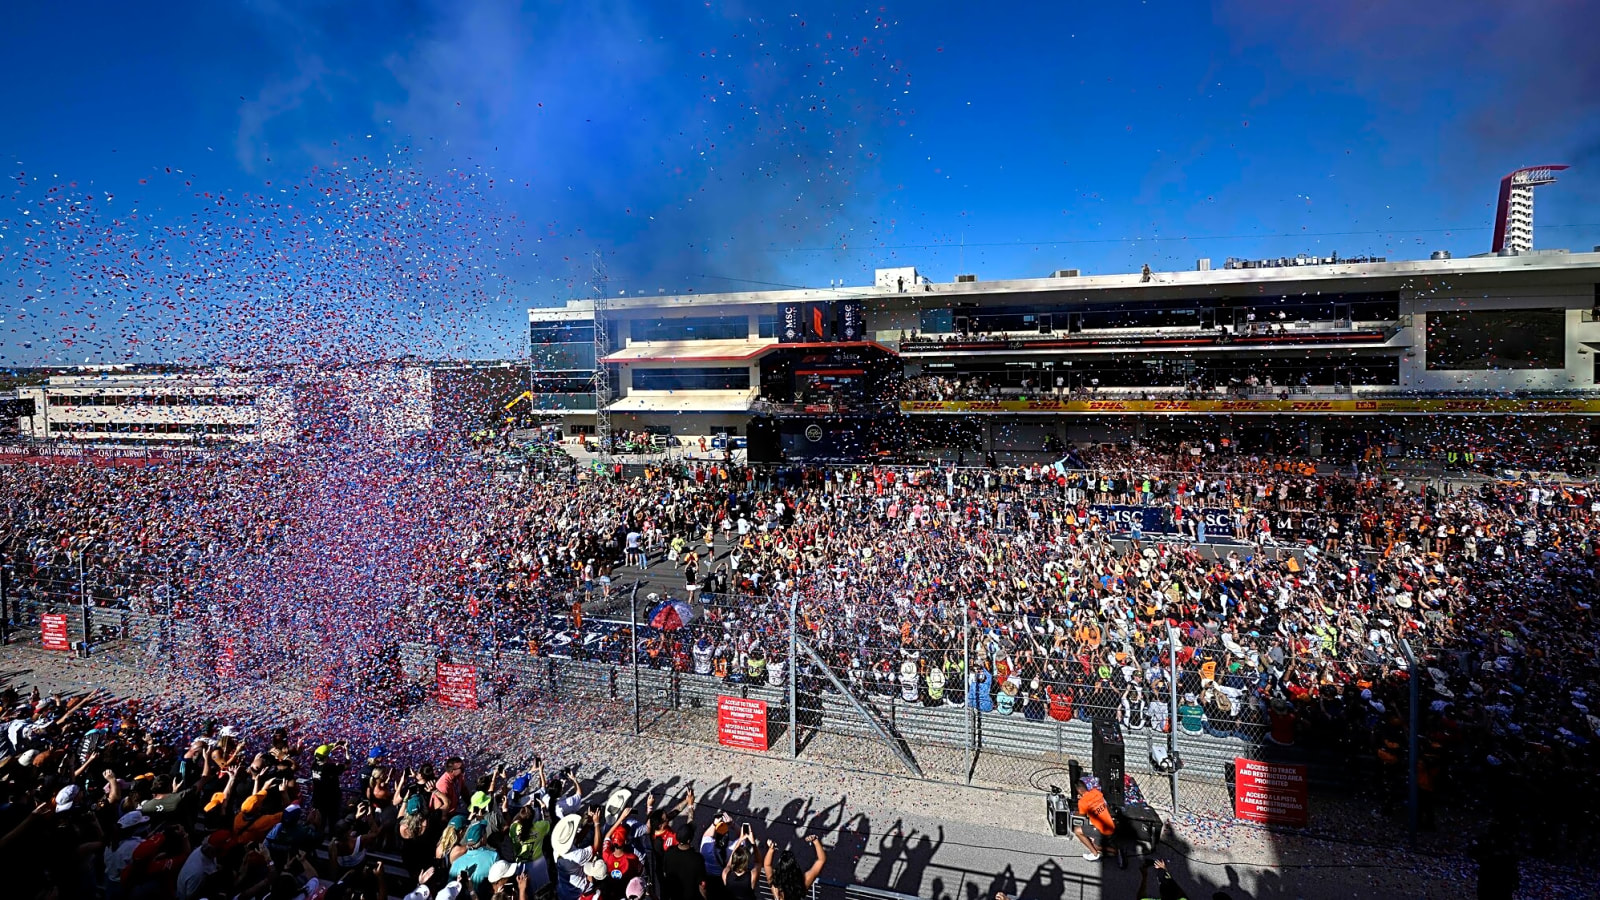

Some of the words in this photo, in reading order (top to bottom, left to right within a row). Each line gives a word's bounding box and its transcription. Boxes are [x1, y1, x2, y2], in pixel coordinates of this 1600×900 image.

[785, 307, 793, 328] MSC
[1240, 768, 1252, 776] AND
[1252, 770, 1287, 780] RESTRICTED
[1246, 763, 1268, 772] ACCESS
[1278, 767, 1297, 775] TRACK
[1255, 778, 1289, 787] PROHIBITED
[1246, 791, 1268, 800] ACCESO
